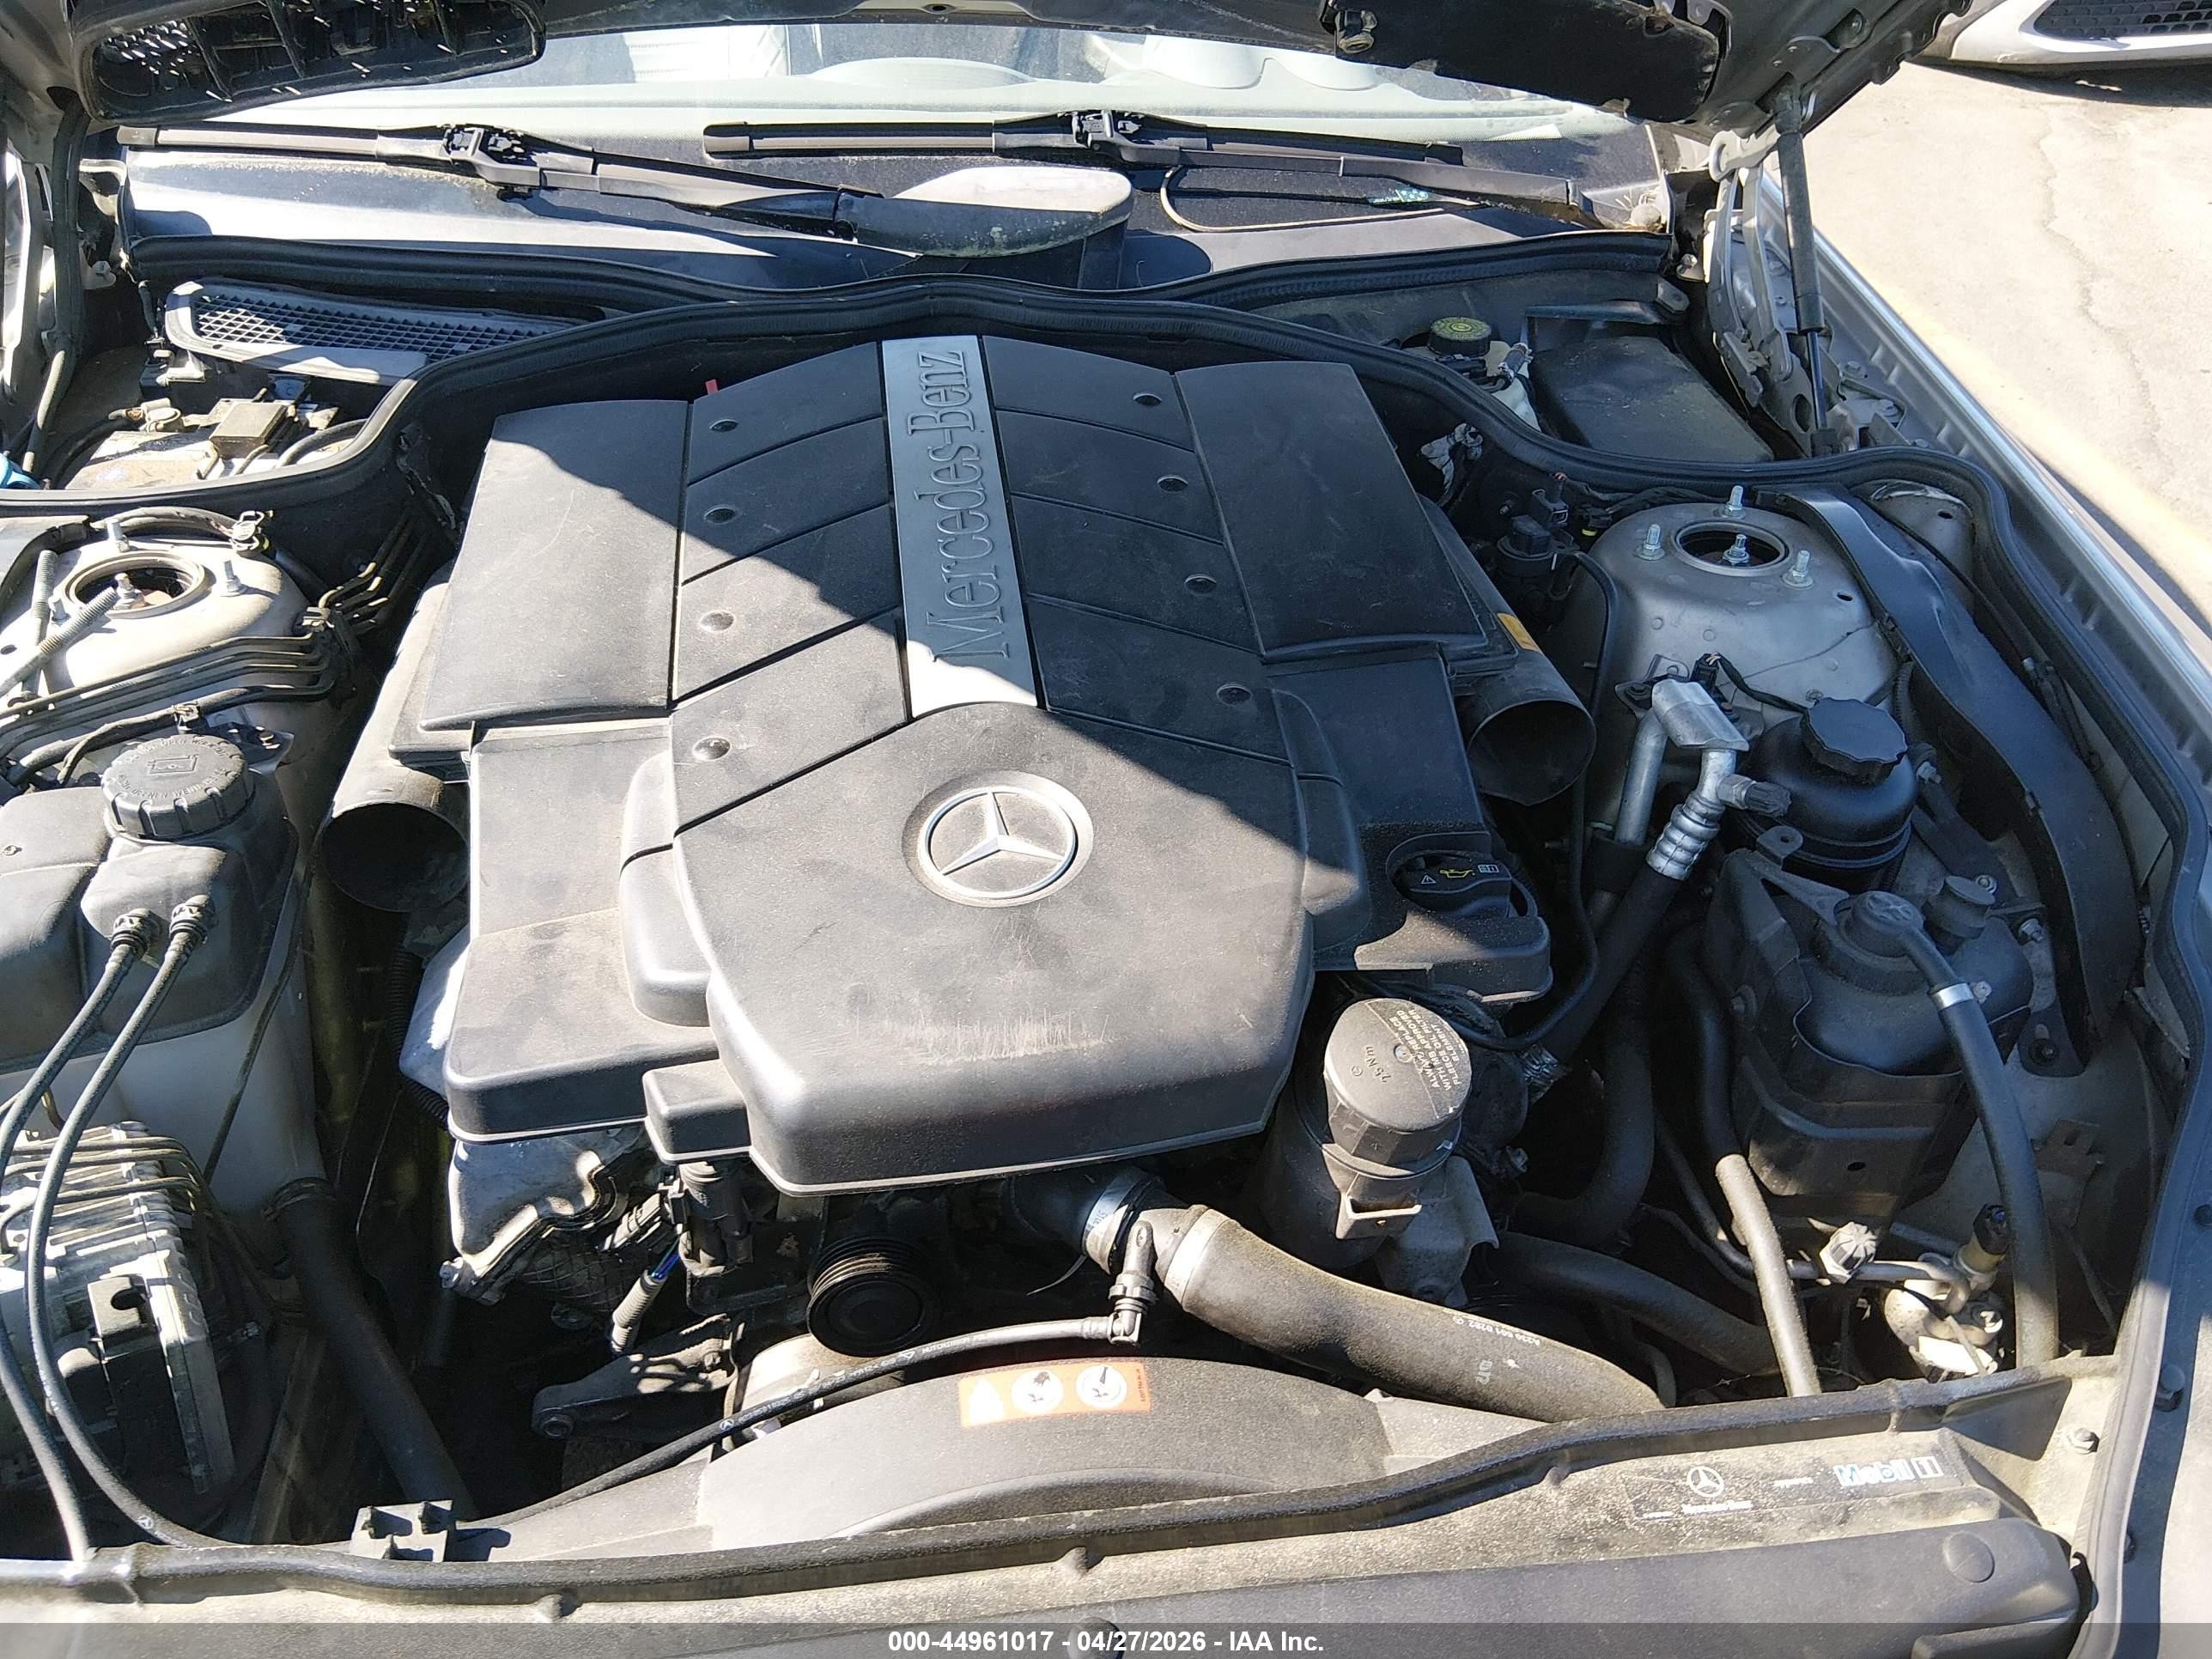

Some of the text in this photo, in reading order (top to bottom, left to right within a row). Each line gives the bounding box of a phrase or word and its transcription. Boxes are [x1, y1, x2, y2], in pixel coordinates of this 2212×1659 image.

[906, 349, 1011, 663] Mercedes-Benz
[1389, 1017, 1419, 1051] REPLACE
[1408, 1009, 1433, 1035] FILTER
[1396, 1010, 1452, 1091] WITH MB APPROVED
[1429, 1036, 1442, 1050] OIL
[1832, 1458, 1916, 1487] Mobil
